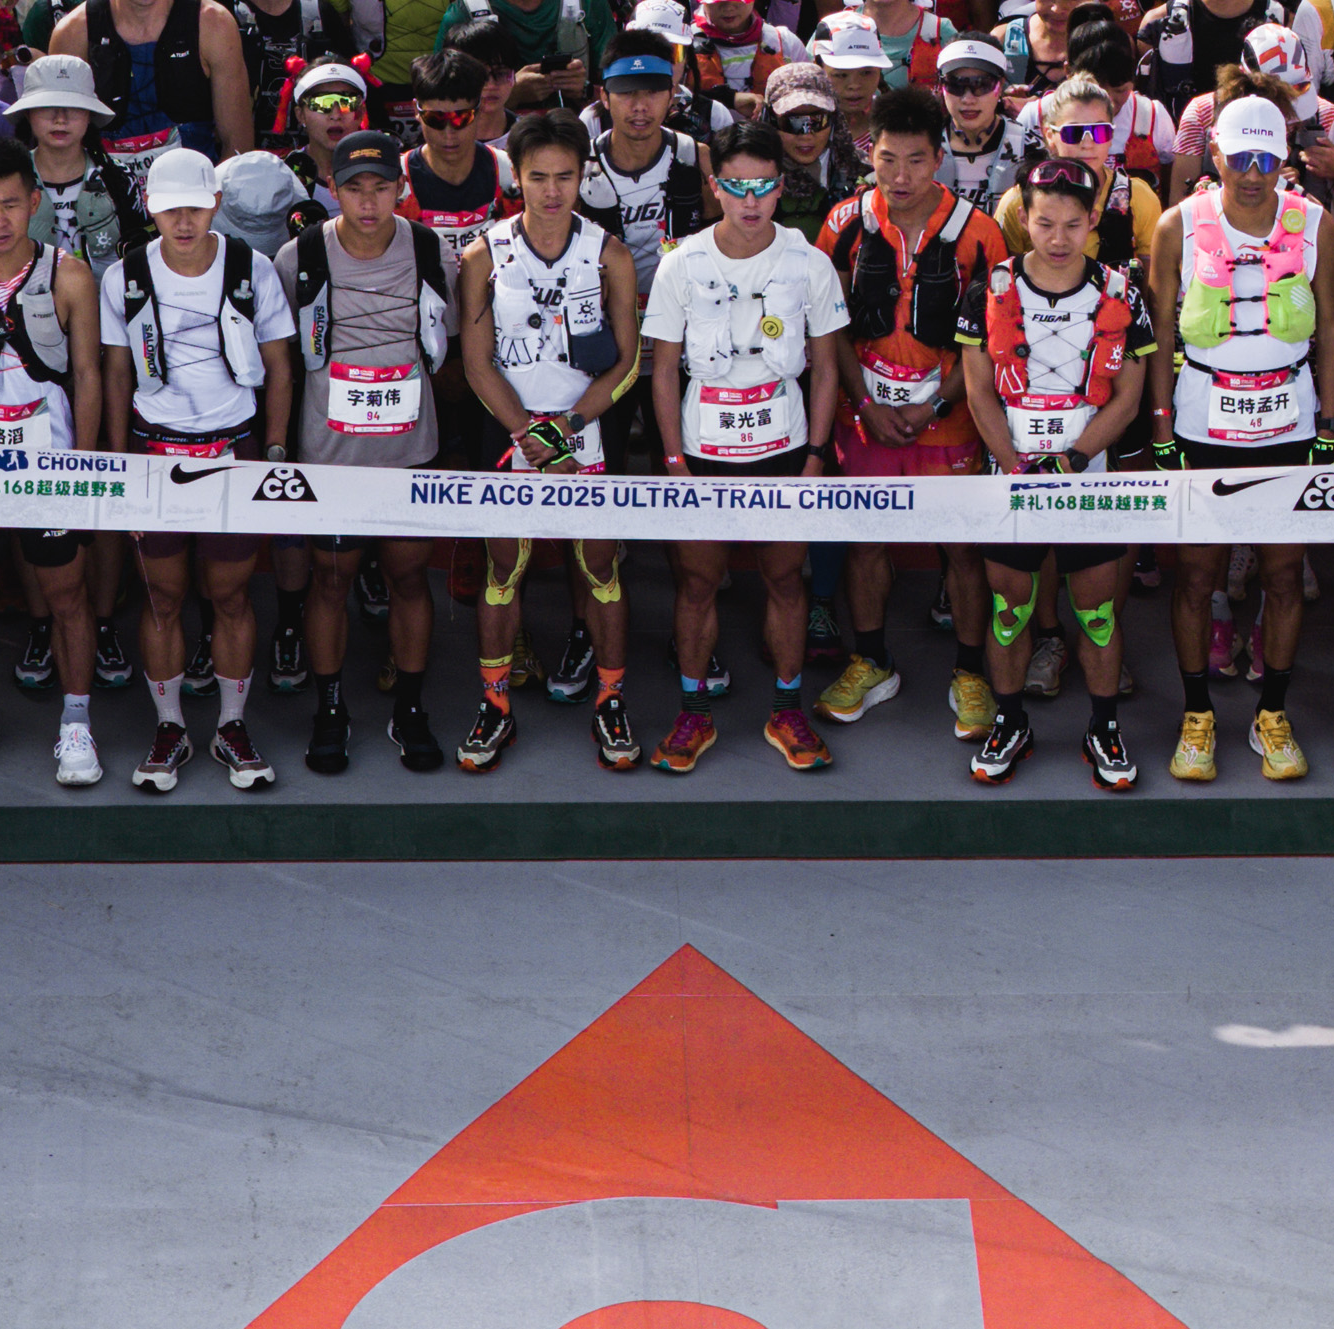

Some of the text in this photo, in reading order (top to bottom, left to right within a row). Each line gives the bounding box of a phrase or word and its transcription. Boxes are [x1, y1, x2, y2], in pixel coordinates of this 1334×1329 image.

[1241, 128, 1273, 137] CHINA
[314, 304, 326, 356] SALOMON
[139, 322, 157, 378] SALOMON
[347, 387, 401, 408] 字菊伟
[876, 381, 910, 402] 张交
[1220, 392, 1289, 415] 巴特孟开
[367, 410, 380, 421] 94
[719, 407, 772, 429] 蒙光富
[1249, 417, 1262, 429] 48
[1028, 418, 1065, 436] 王磊
[740, 433, 754, 443] 86
[1039, 439, 1053, 450] 58
[38, 456, 126, 472] CHONGLI
[411, 483, 913, 510] NIKE ACG 2025 ULTRA-TRAIL CHONGLI
[1010, 495, 1166, 511] 崇礼168超级越野赛
